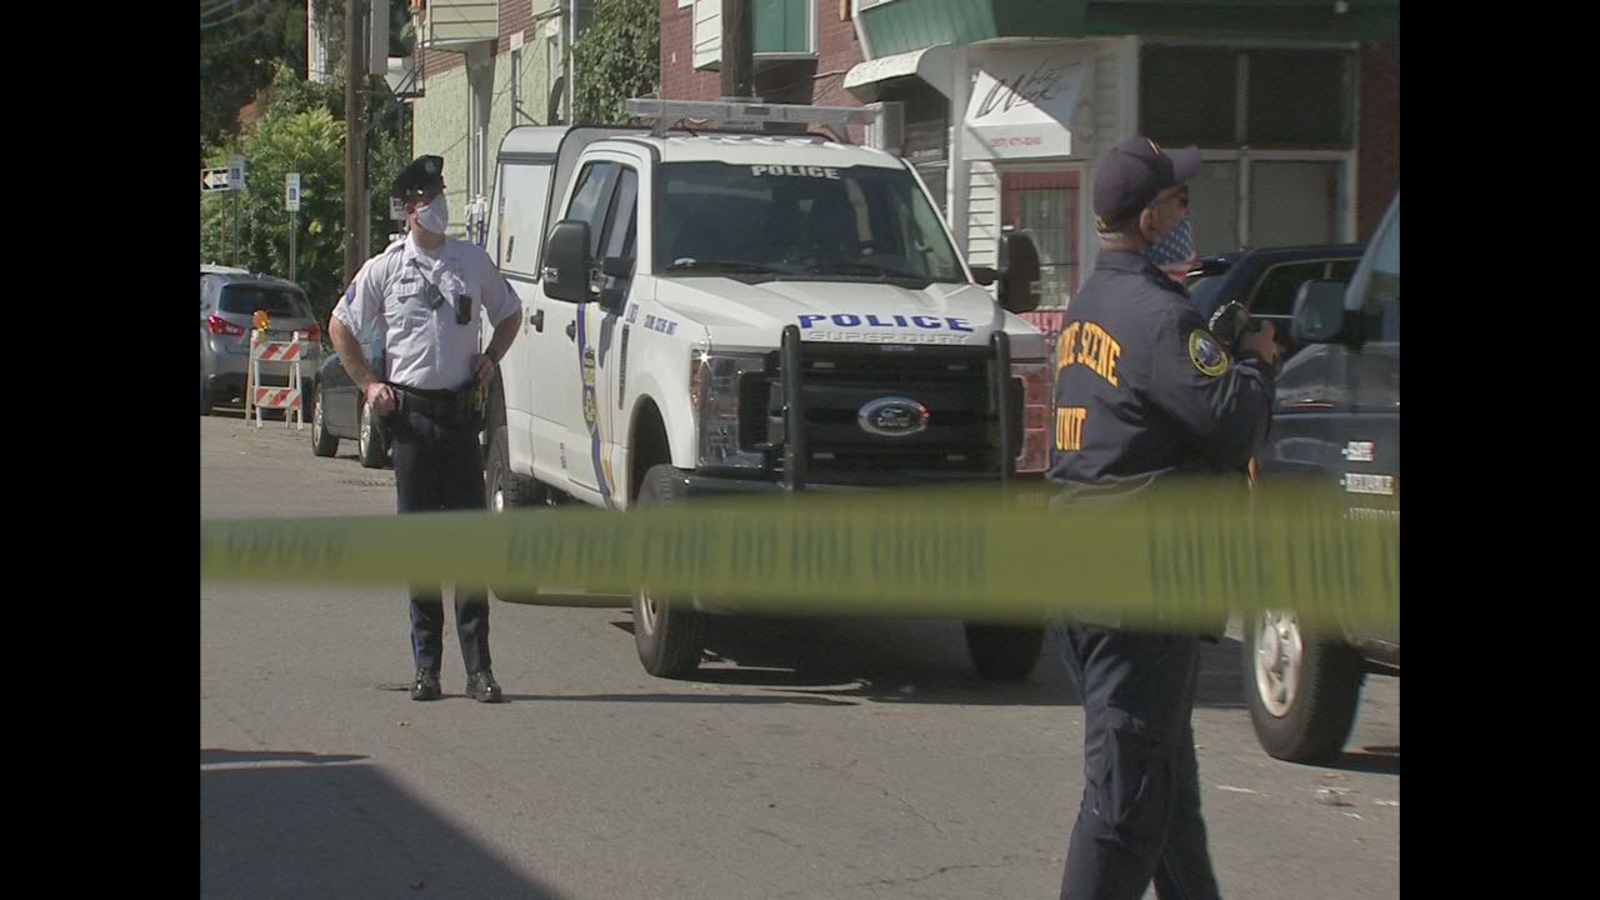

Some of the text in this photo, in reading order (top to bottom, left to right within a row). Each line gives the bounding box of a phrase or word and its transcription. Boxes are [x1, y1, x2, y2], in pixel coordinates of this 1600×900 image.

[751, 165, 840, 180] POLICE
[798, 314, 974, 332] POLICE
[809, 330, 971, 344] SUPER DUTY
[1078, 321, 1120, 388] SCENE
[1056, 407, 1087, 450] UNIT
